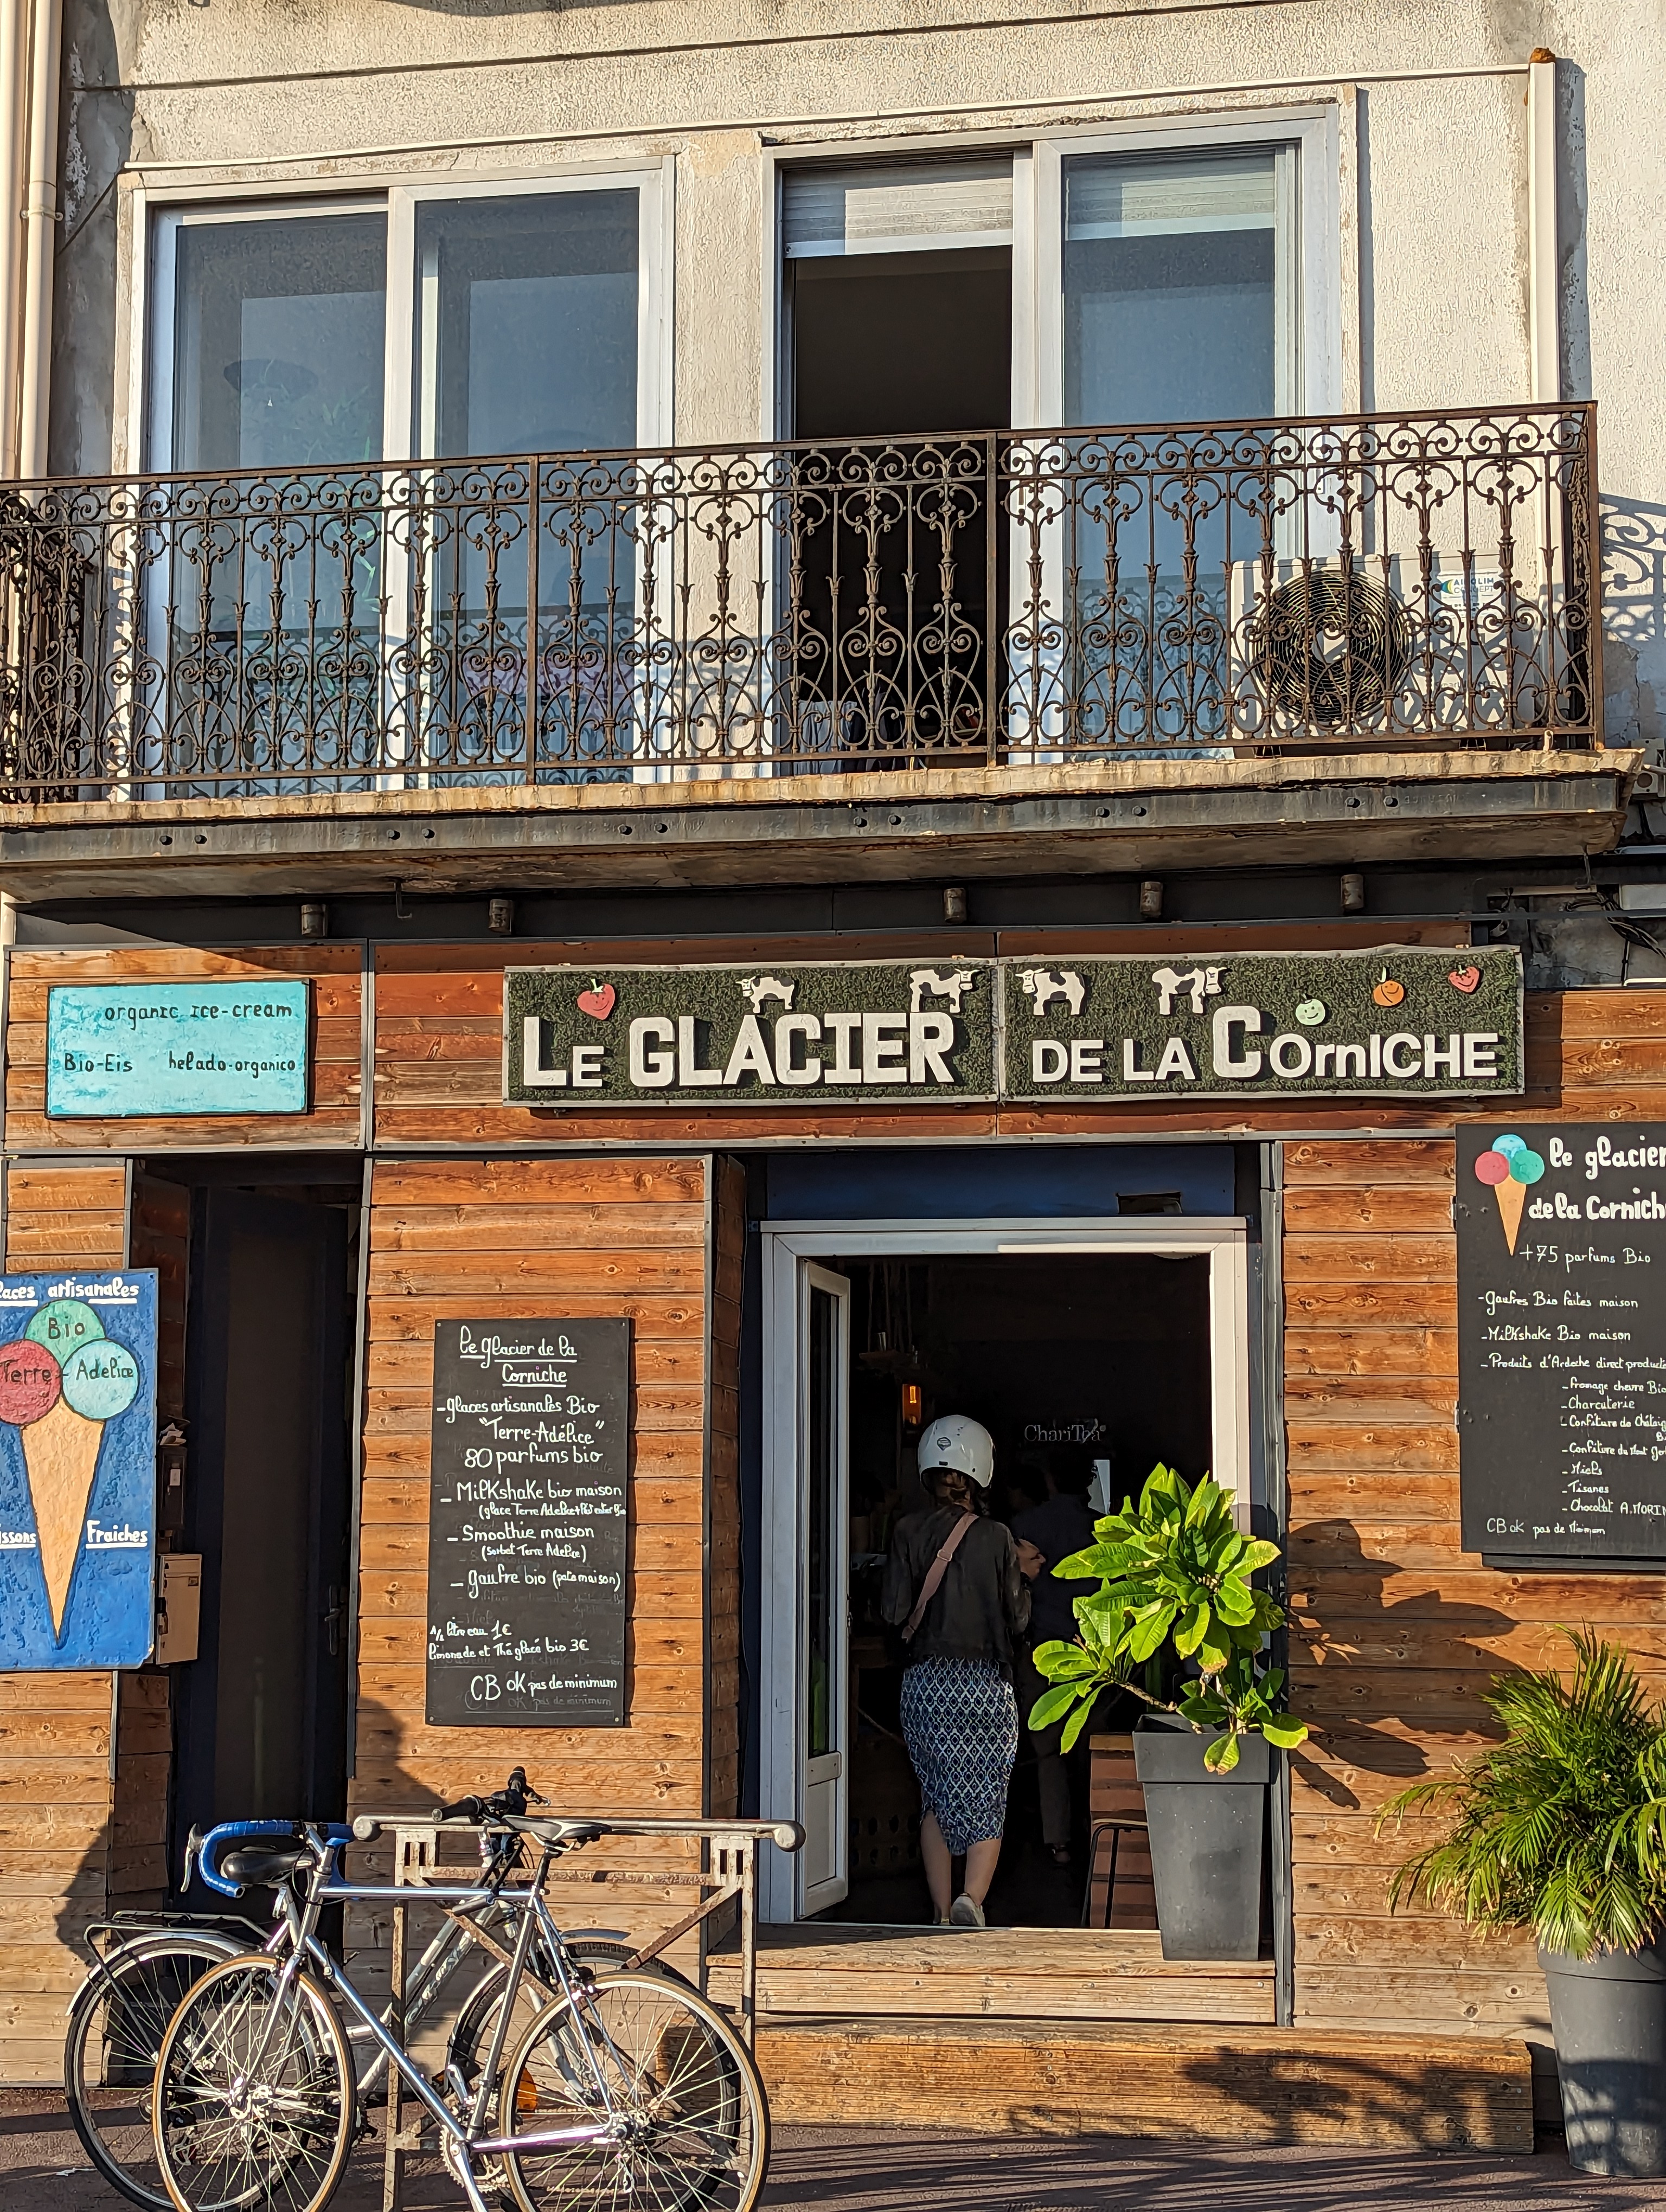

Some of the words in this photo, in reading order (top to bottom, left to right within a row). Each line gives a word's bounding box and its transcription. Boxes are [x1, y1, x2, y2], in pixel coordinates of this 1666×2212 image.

[105, 1005, 178, 1030] organic
[629, 1011, 954, 1086] GLACIER
[1032, 1039, 1103, 1082] DE
[1123, 1037, 1196, 1082] LA
[65, 1052, 133, 1073] Bio-Eis
[169, 1050, 296, 1079] helado-organico
[1585, 1135, 1666, 1180] glacier
[1586, 1187, 1666, 1220] Cornich
[1519, 1244, 1558, 1263] +75
[1565, 1246, 1616, 1273] parfums
[1622, 1248, 1651, 1264] Bio
[48, 1277, 139, 1297] artisanales
[1533, 1291, 1558, 1306] Bio
[1564, 1290, 1592, 1307] faites
[1599, 1295, 1638, 1308] maison
[48, 1316, 85, 1340] Bio
[1557, 1324, 1581, 1341] Bio
[1589, 1328, 1631, 1341] maison
[480, 1335, 535, 1368] glacier
[538, 1338, 555, 1356] de
[559, 1335, 578, 1356] la
[502, 1364, 568, 1383] Corniche
[491, 1394, 562, 1412] artisanales
[566, 1395, 600, 1415] Bio
[464, 1448, 493, 1468] 80
[496, 1442, 568, 1475] parfums
[573, 1445, 603, 1463] bio
[548, 1478, 573, 1497] bio
[576, 1481, 622, 1496] maison
[87, 1520, 148, 1544] Fraiches
[462, 1521, 536, 1542] Smoothie
[541, 1521, 595, 1539] maison
[1487, 1518, 1507, 1534] CB
[1533, 1525, 1550, 1539] pas
[1554, 1522, 1566, 1534] de
[468, 1563, 521, 1599] gaufre
[524, 1566, 546, 1585] bio
[478, 1645, 491, 1656] et
[546, 1637, 566, 1652] bio
[471, 1675, 502, 1701] CB
[528, 1682, 547, 1697] pas
[549, 1675, 564, 1689] de
[565, 1674, 617, 1688] minimum
